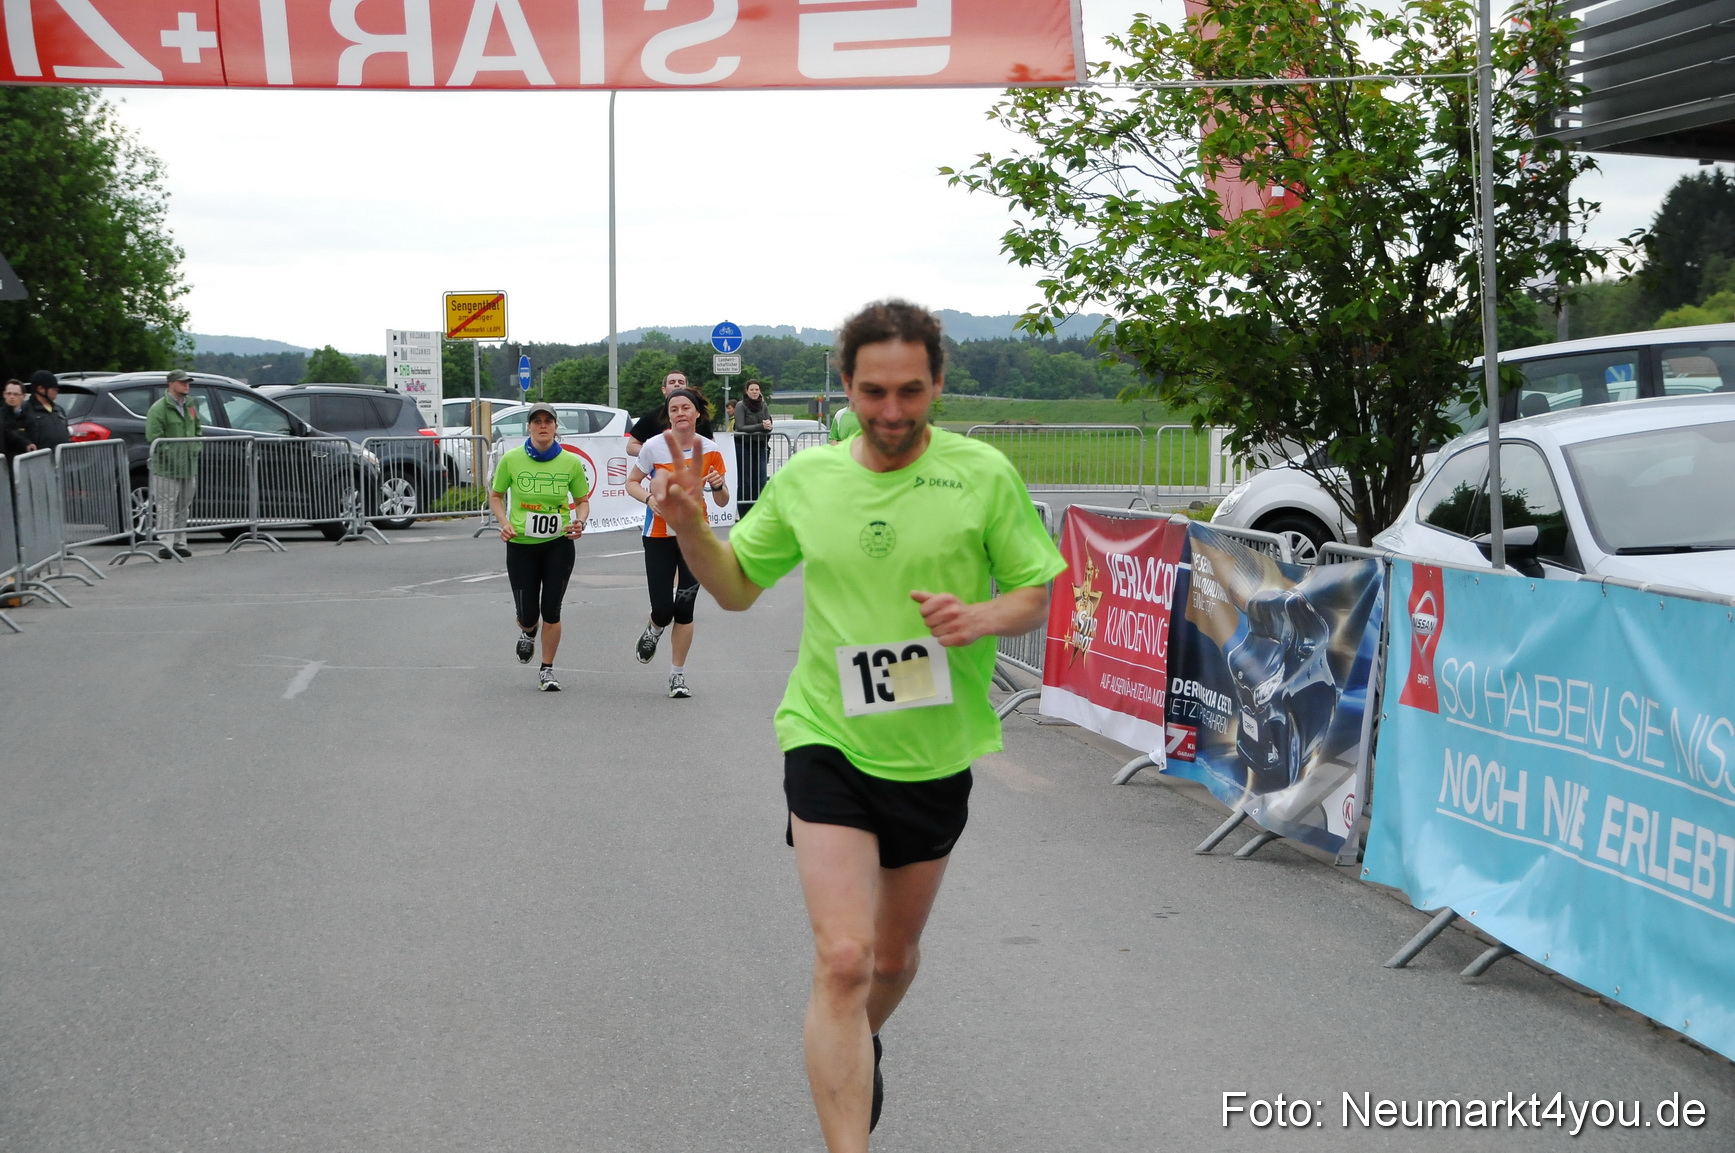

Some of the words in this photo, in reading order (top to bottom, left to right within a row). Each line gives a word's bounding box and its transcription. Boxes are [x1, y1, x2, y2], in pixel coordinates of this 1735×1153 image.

[451, 299, 500, 314] Sengenthal
[516, 470, 571, 495] OPF
[928, 477, 963, 489] DEKRA
[602, 489, 626, 498] SEA
[531, 514, 558, 535] 109
[589, 517, 602, 530] Tel.
[1412, 616, 1436, 632] NISSAN
[1441, 656, 1476, 720] SO
[1484, 665, 1610, 751] HABEN
[1615, 690, 1665, 769] SIE
[1670, 706, 1735, 795] NIS
[1165, 725, 1189, 754] 7
[1438, 747, 1528, 831] NOCH
[1543, 775, 1591, 852] NIE
